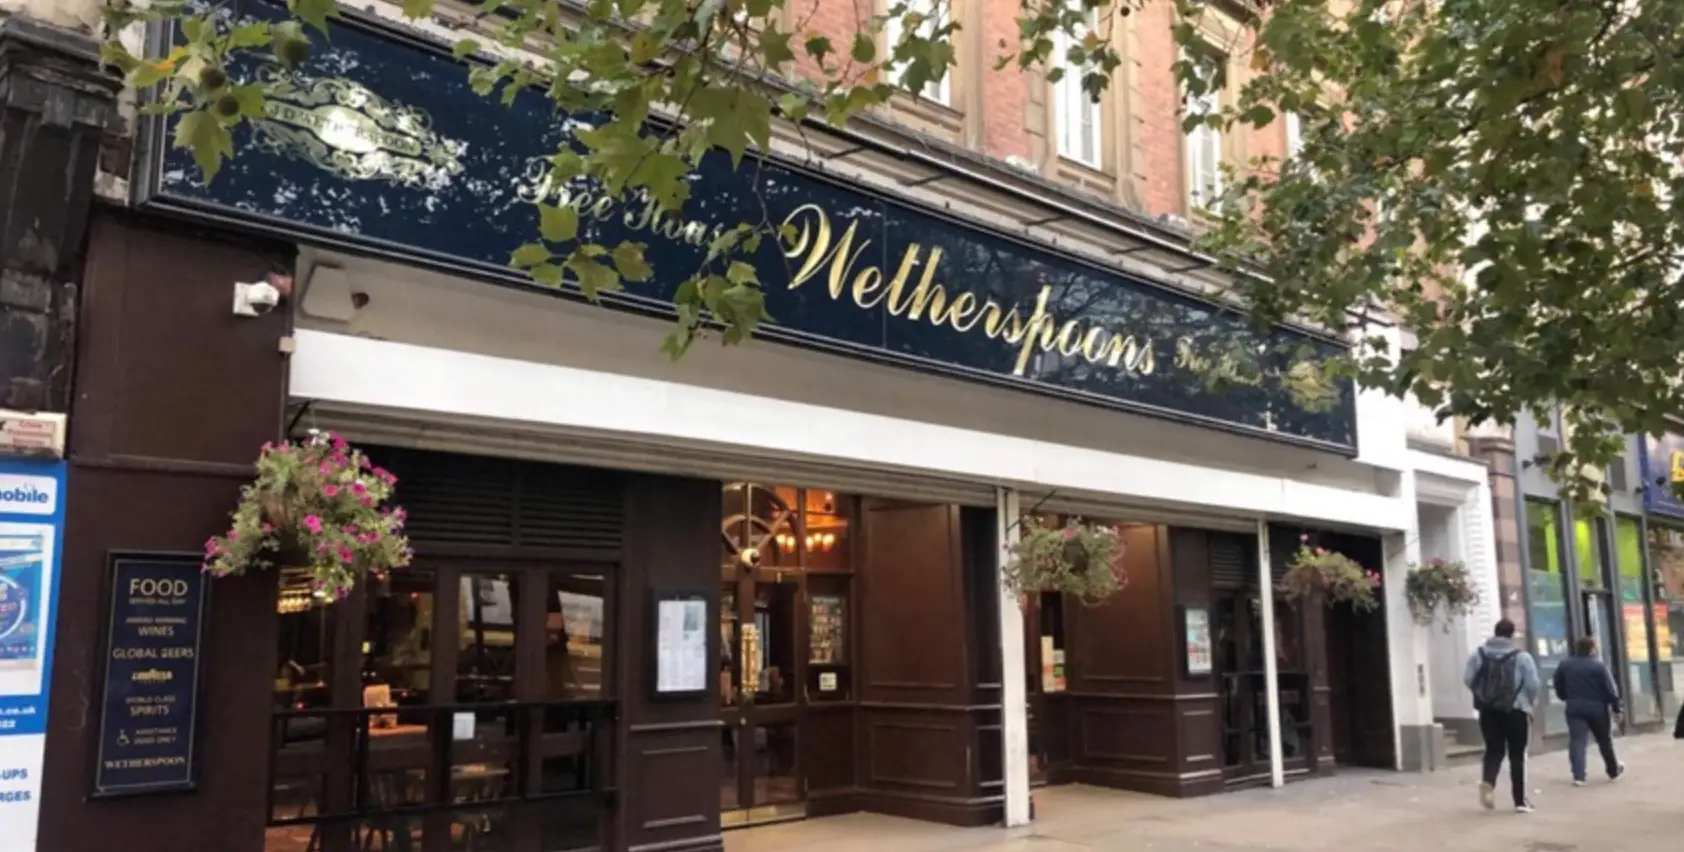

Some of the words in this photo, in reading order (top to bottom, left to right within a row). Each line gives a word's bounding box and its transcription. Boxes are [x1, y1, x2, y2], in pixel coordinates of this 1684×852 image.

[269, 103, 279, 117] J
[283, 107, 295, 120] D
[300, 111, 416, 150] WETHRSPOON
[780, 203, 1154, 376] Wetherspoons
[0, 488, 48, 504] obile
[129, 578, 188, 596] FOOD
[138, 626, 174, 636] WINES
[112, 648, 157, 659] GLOBAL
[161, 647, 194, 658] BEERS
[129, 704, 169, 716] SPIRITS
[104, 756, 186, 769] WETHERSPOON
